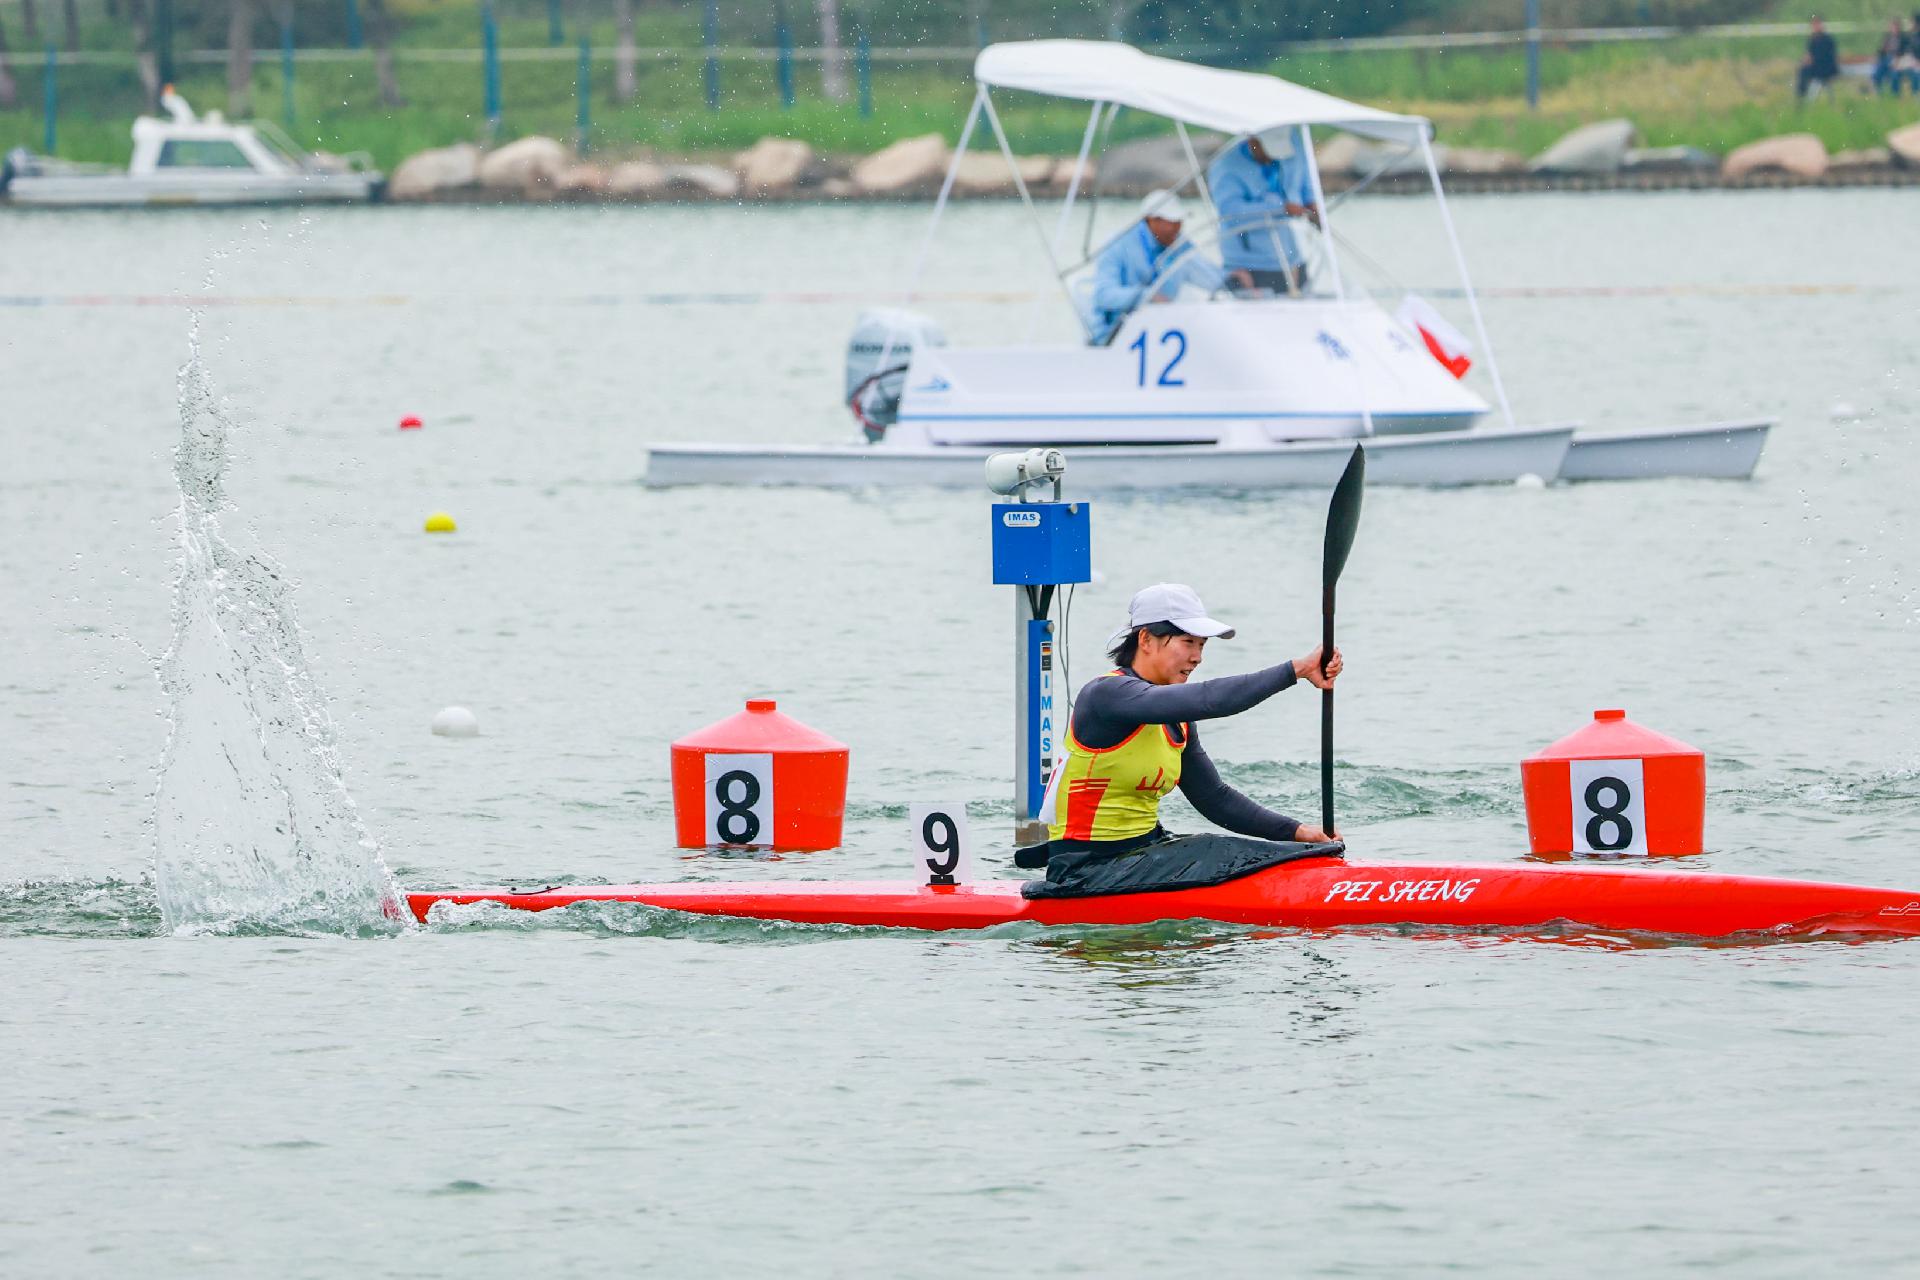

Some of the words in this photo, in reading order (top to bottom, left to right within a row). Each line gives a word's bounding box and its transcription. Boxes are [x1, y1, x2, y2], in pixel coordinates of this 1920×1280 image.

[1130, 330, 1187, 387] 12
[1008, 513, 1036, 521] IMAS
[1041, 674, 1052, 753] IMAS
[715, 769, 760, 844] 8
[1584, 776, 1633, 851] 8
[922, 811, 960, 875] 9
[1323, 880, 1383, 903] PEI
[1378, 878, 1481, 903] SHENG
